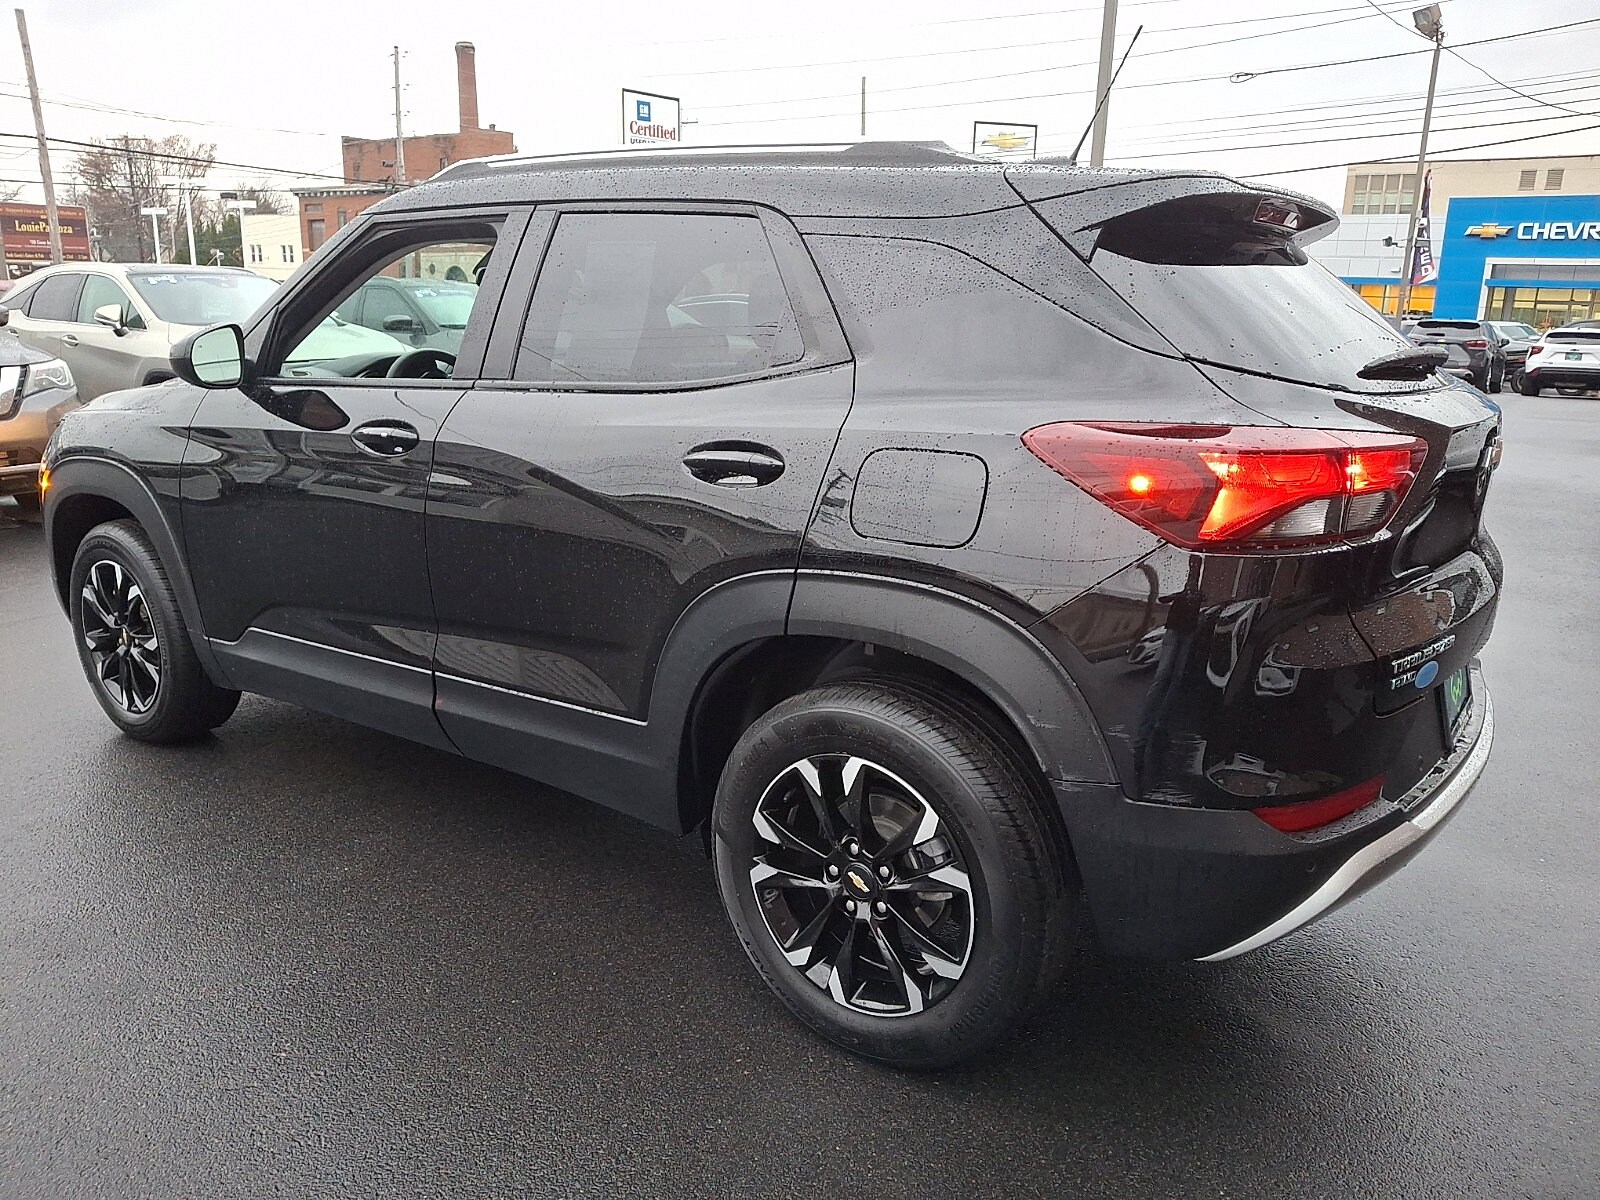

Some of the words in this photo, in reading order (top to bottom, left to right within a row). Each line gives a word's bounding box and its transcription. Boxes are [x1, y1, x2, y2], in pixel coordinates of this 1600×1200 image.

[630, 121, 676, 141] Certified
[15, 220, 73, 234] LouiePaoza
[1517, 222, 1600, 240] CHEVR
